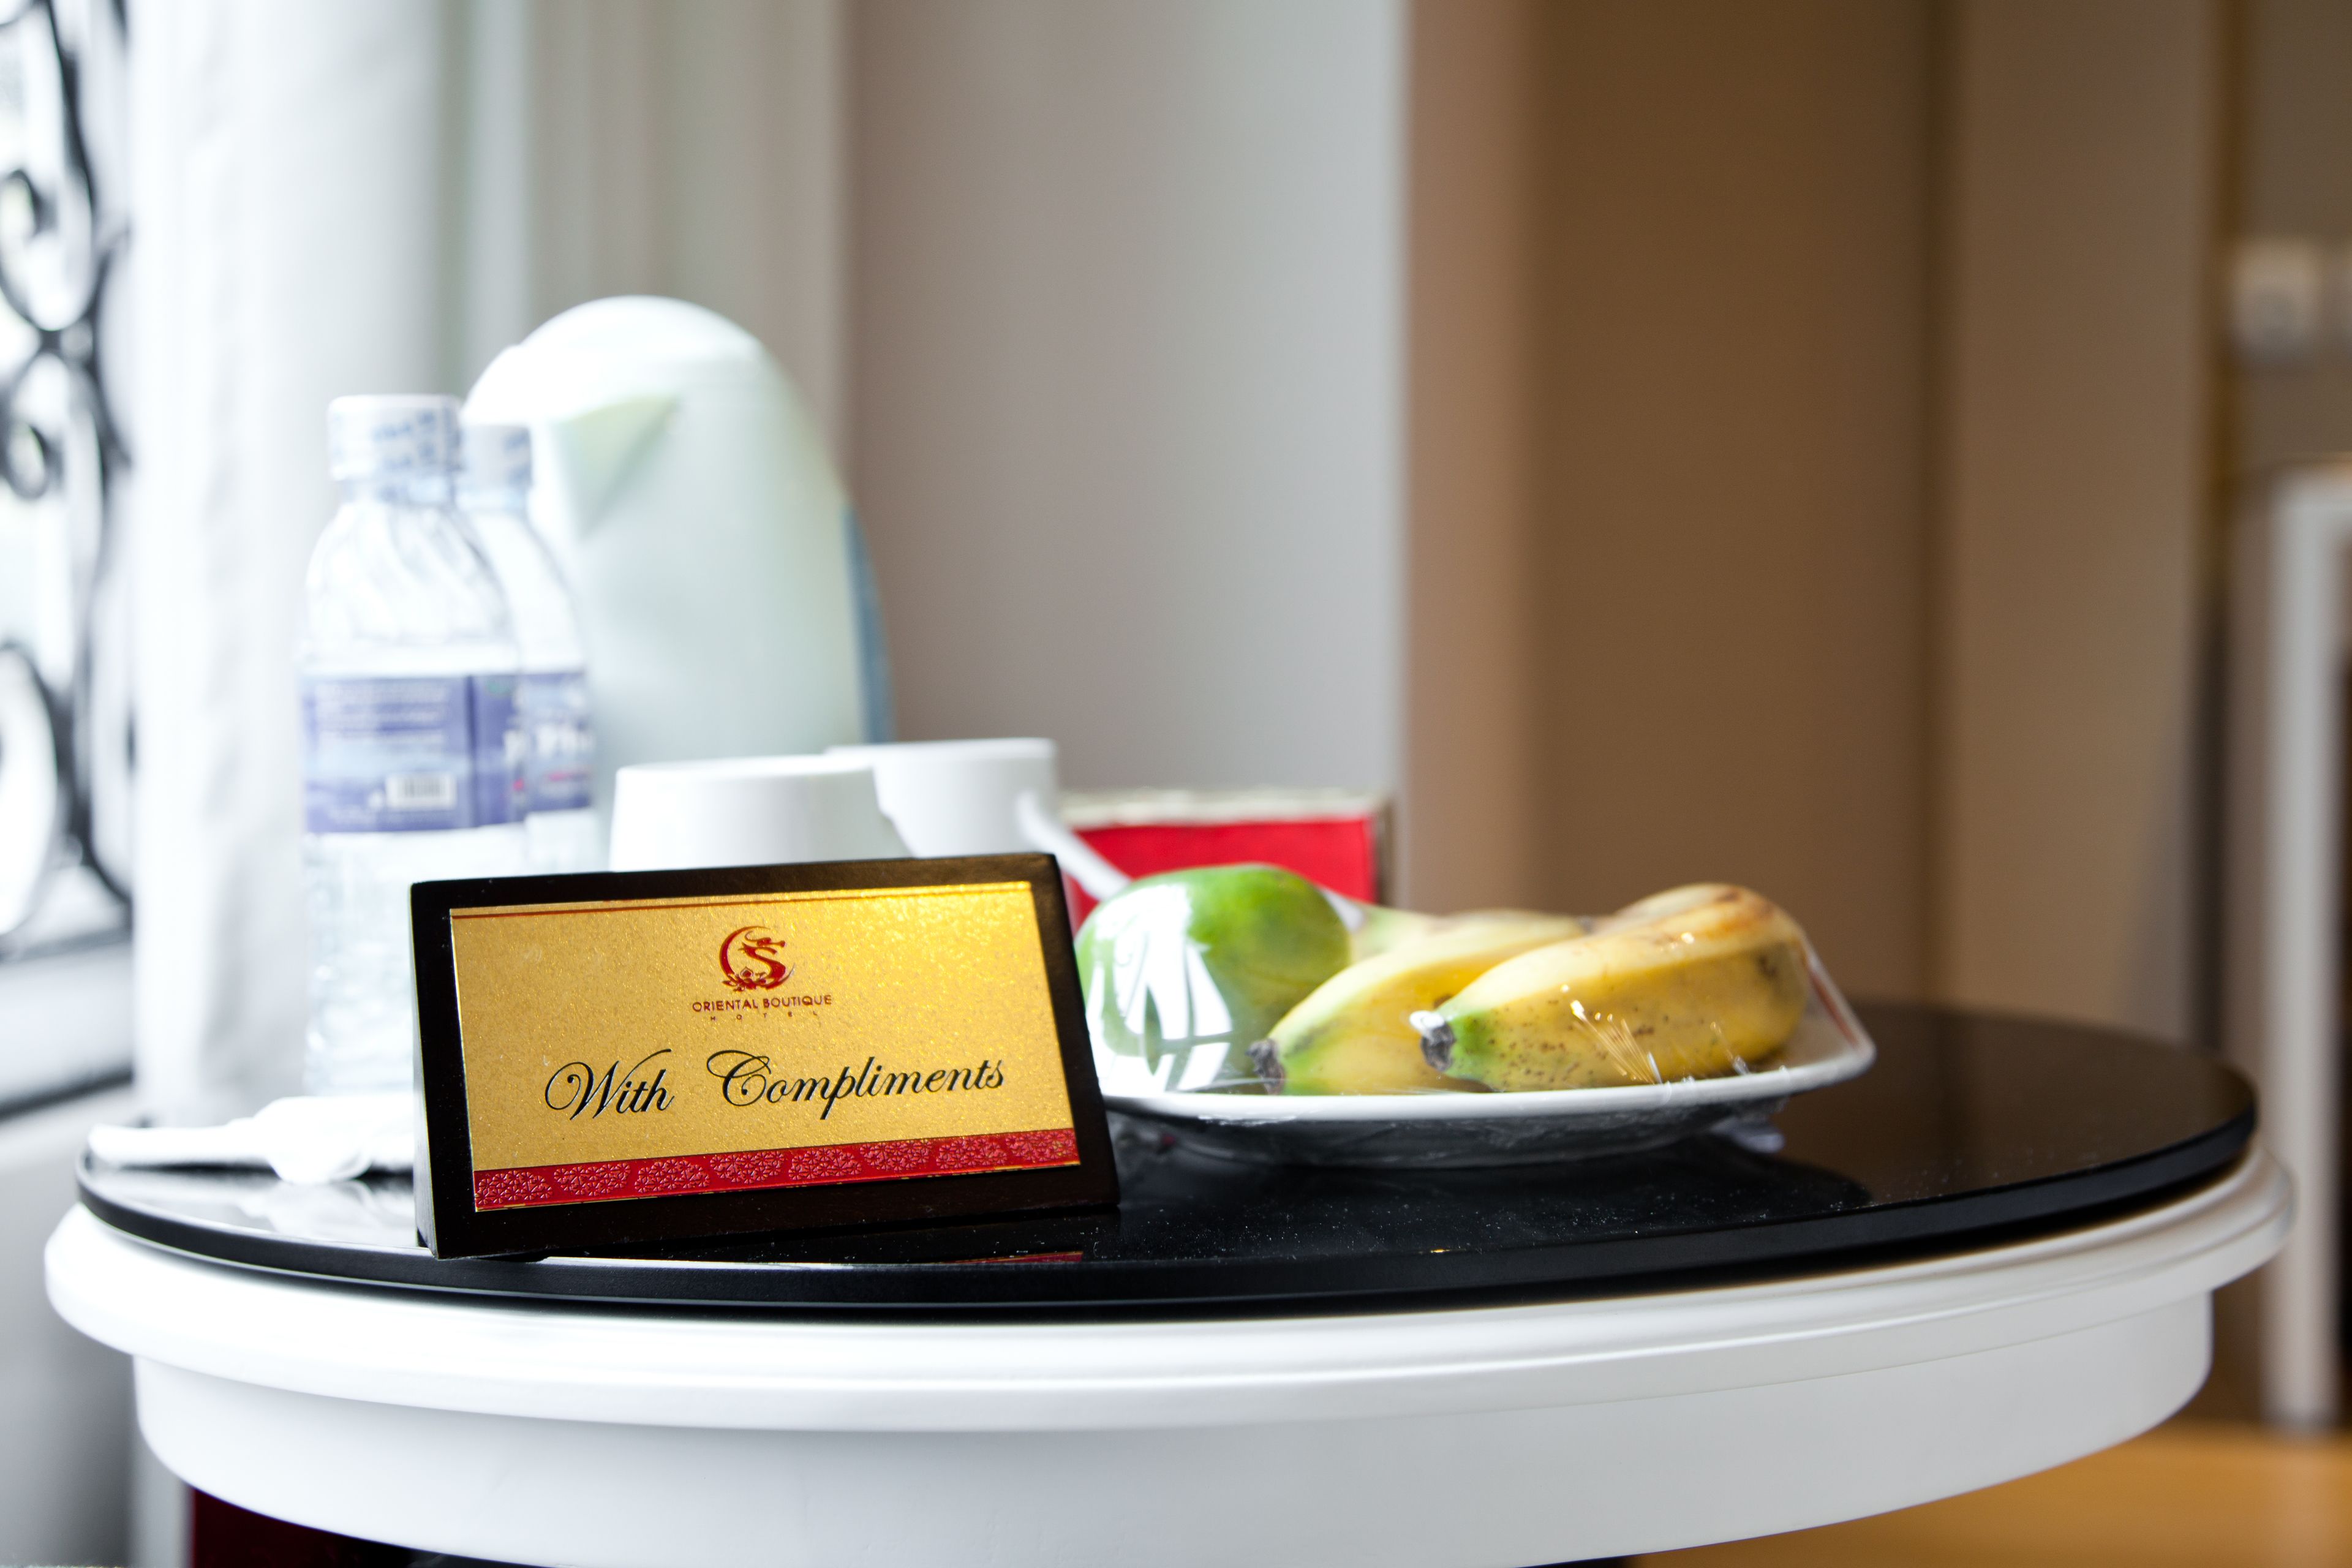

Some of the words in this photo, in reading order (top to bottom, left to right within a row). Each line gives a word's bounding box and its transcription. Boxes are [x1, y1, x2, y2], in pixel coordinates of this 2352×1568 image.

[692, 998, 758, 1012] ORIENTAL
[763, 995, 832, 1008] BOUTIQUE
[710, 1011, 818, 1021] HOTEL
[545, 1049, 675, 1121] With
[706, 1049, 1005, 1120] Compliments
